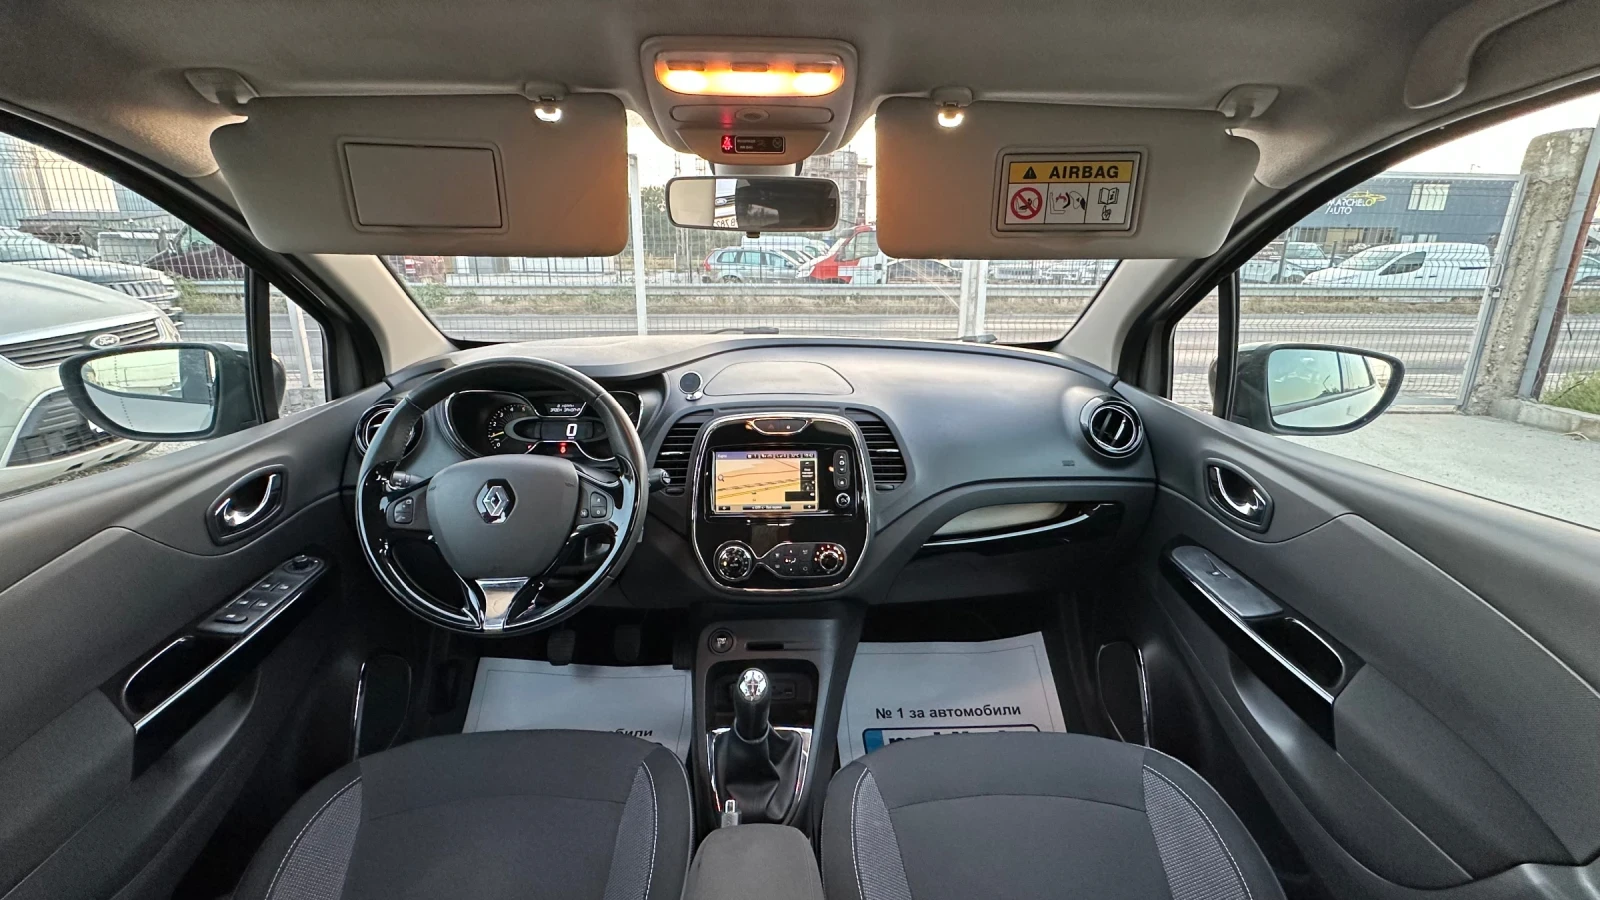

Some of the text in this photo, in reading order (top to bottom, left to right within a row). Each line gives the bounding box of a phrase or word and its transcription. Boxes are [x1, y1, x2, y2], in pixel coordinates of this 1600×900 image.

[1049, 165, 1119, 179] AIRBAG
[566, 423, 578, 436] 0
[876, 704, 1022, 719] № 1 за автомобили
